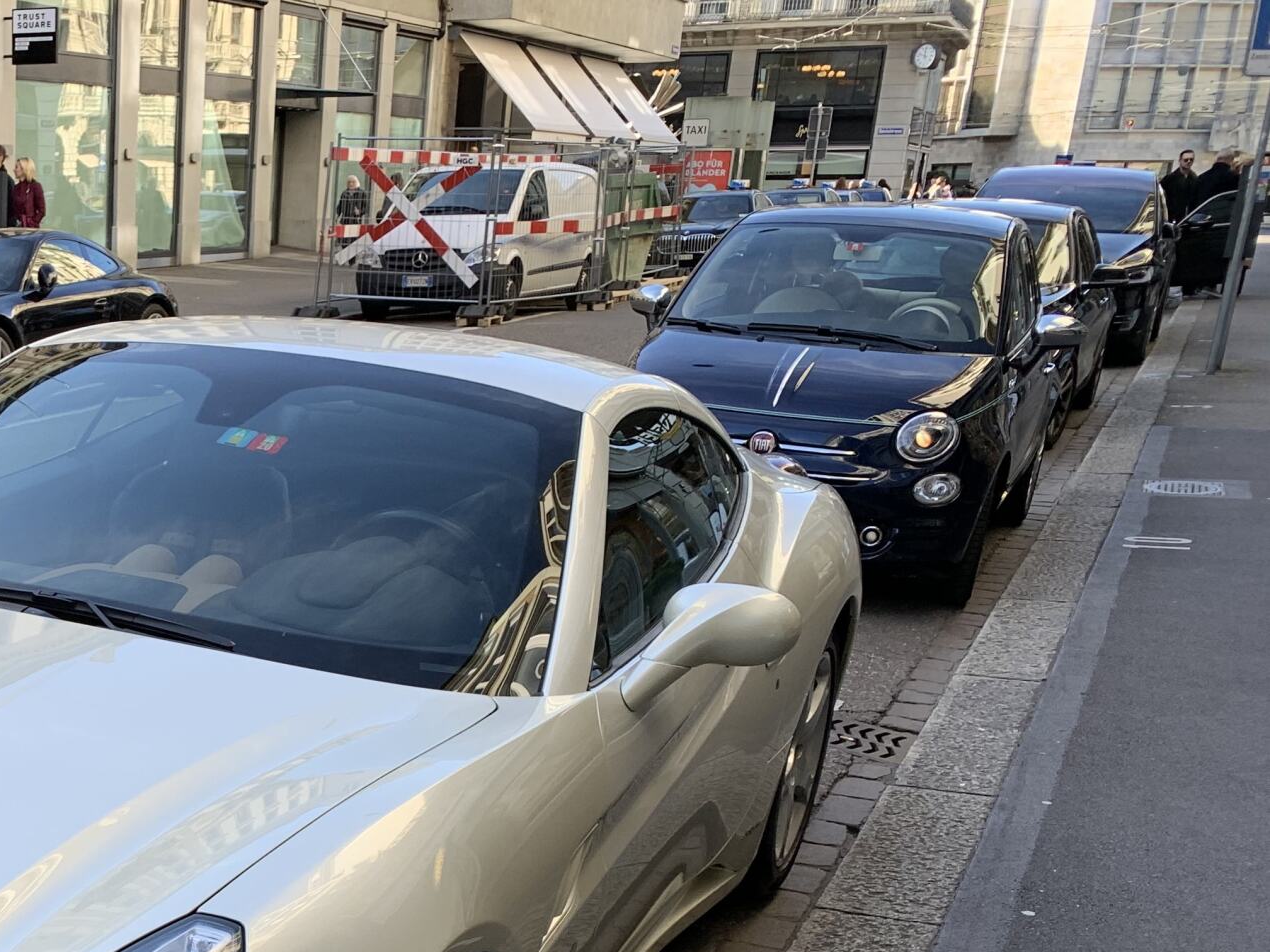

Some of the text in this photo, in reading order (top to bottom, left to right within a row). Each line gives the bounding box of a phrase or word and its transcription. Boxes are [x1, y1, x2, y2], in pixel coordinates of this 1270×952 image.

[17, 21, 51, 29] SQUARE
[686, 125, 707, 135] TAXI
[754, 438, 770, 451] FIAT
